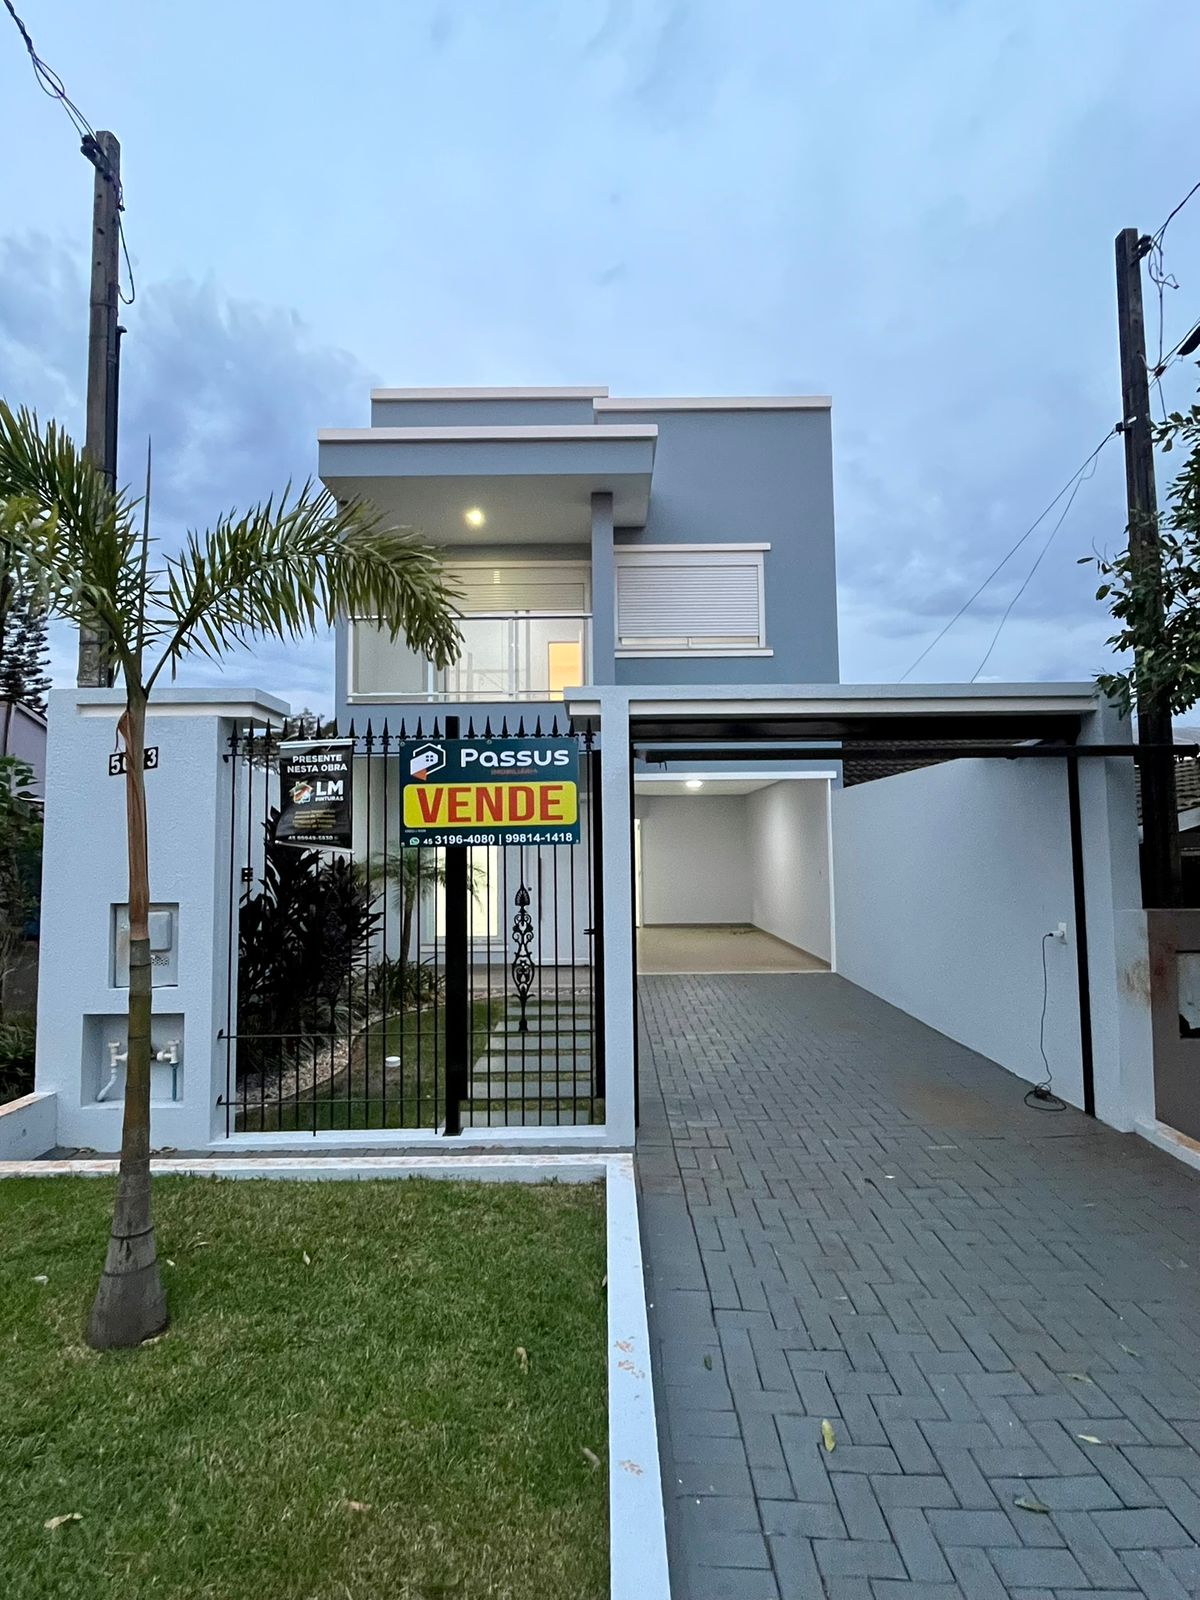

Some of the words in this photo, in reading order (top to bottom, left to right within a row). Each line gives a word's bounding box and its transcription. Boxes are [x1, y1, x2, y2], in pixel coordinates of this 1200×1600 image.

[292, 753, 343, 763] PRESENTE
[460, 748, 570, 768] Passus
[287, 764, 319, 773] NESTA
[320, 763, 348, 772] OBRA
[316, 780, 344, 796] LM
[416, 785, 563, 823] VENDE
[434, 834, 495, 845] 3196-4080
[505, 832, 573, 843] 99814-1418
